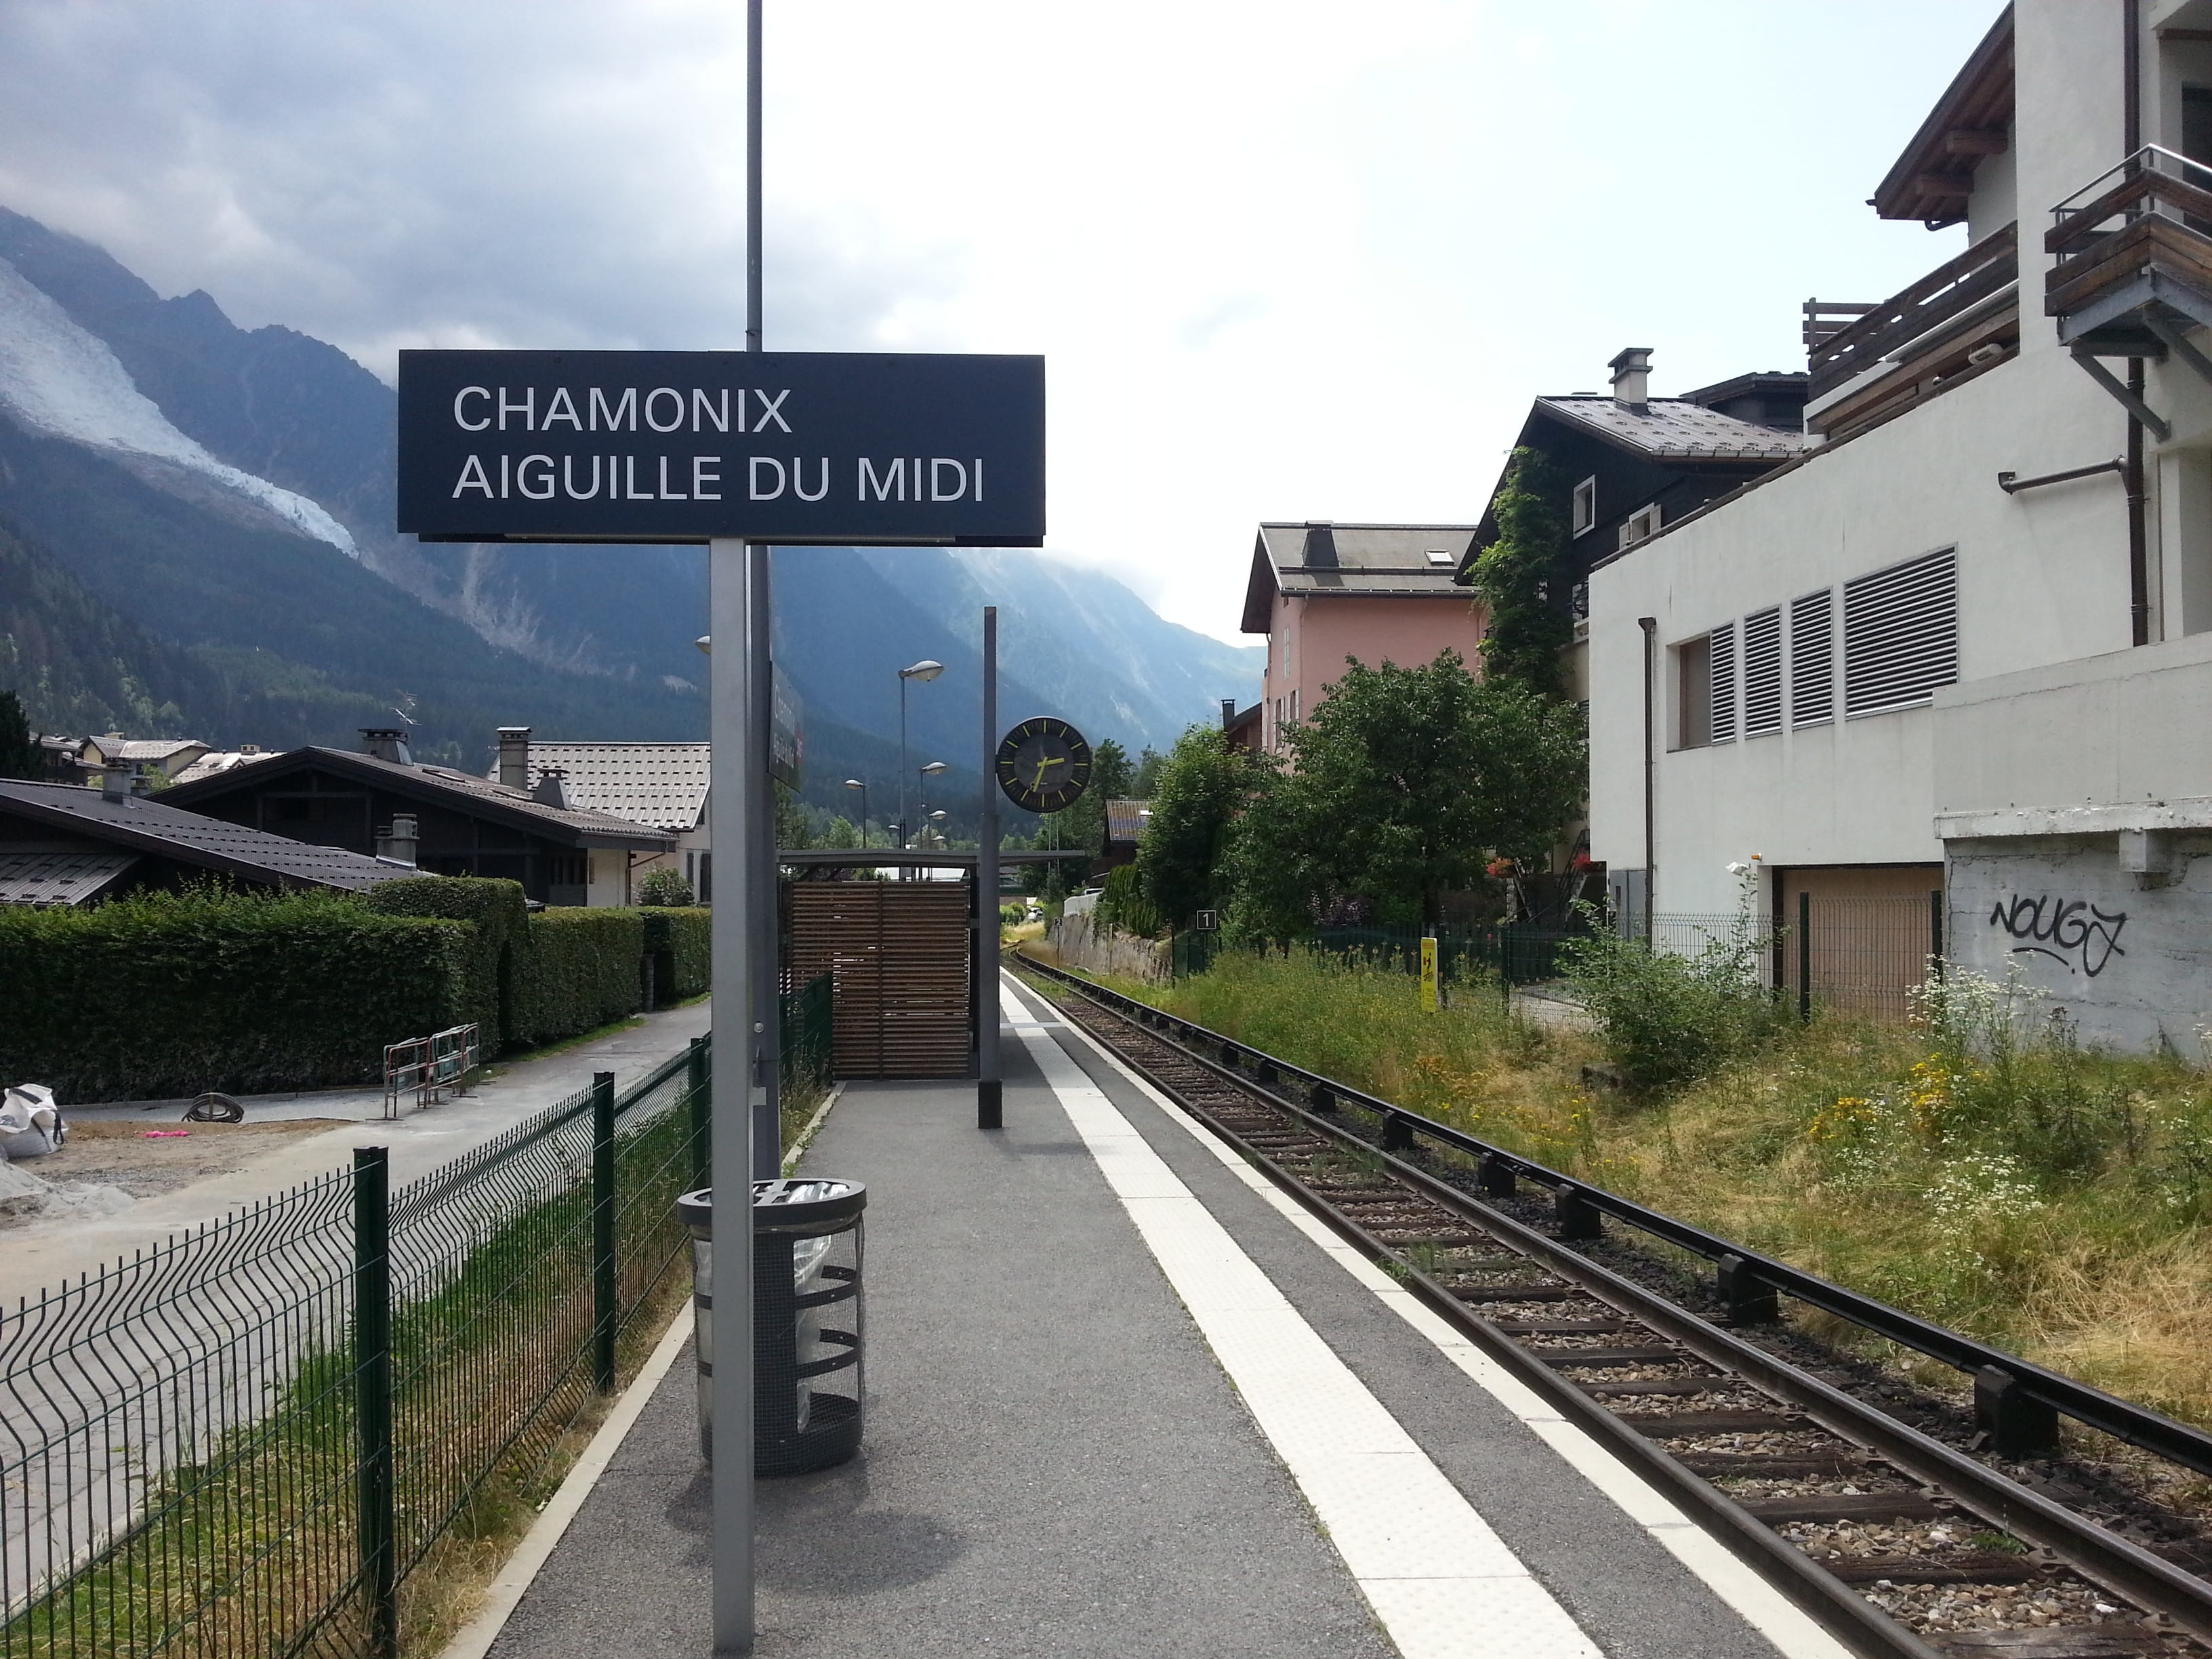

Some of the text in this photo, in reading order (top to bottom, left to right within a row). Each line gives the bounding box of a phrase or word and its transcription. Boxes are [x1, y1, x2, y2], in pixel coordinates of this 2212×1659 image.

[453, 385, 793, 434] CHAMONIX
[451, 454, 983, 502] AIGUILLE DU MIDI
